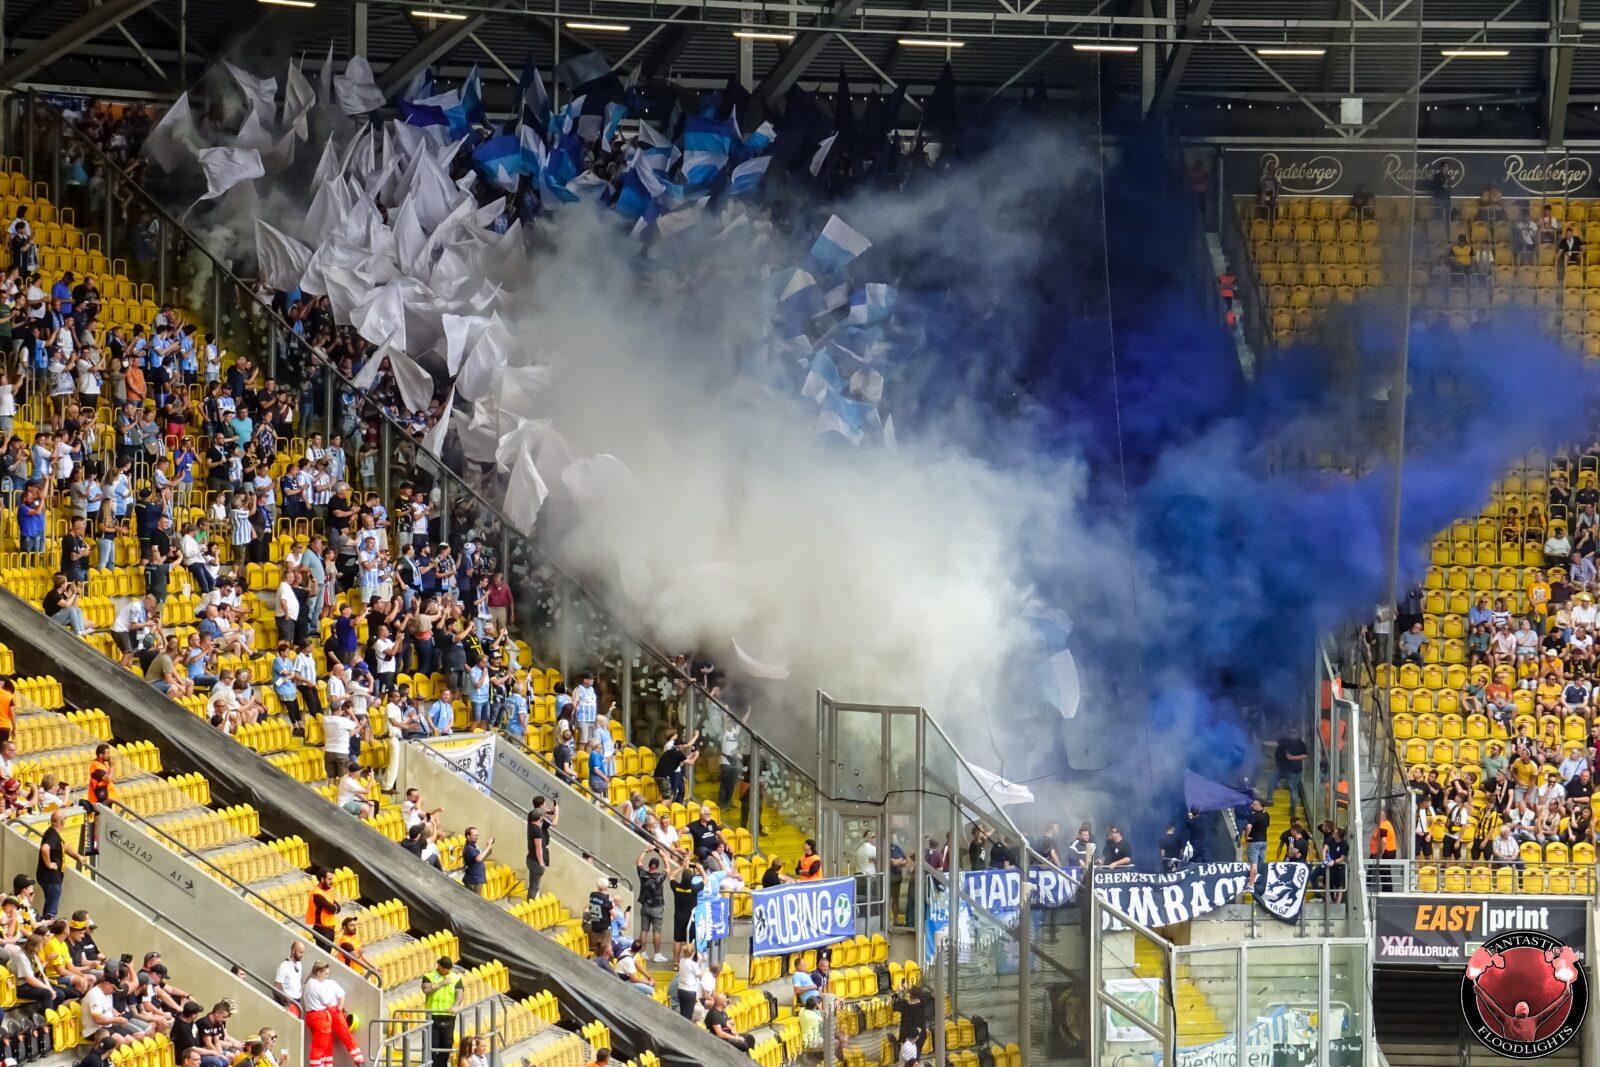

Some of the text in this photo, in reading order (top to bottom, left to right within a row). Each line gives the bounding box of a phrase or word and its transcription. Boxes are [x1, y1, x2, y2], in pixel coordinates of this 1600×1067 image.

[1383, 154, 1461, 186] Radebeer
[1503, 155, 1590, 191] Radeberger
[123, 840, 153, 862] A2 A3
[170, 871, 181, 881] A1
[1095, 869, 1189, 884] GRENZSTADT
[1198, 862, 1250, 876] LÖWEN
[767, 890, 832, 945] AUBING
[1415, 905, 1549, 931] EAST print
[1387, 945, 1459, 957] DIGITALDRUCK
